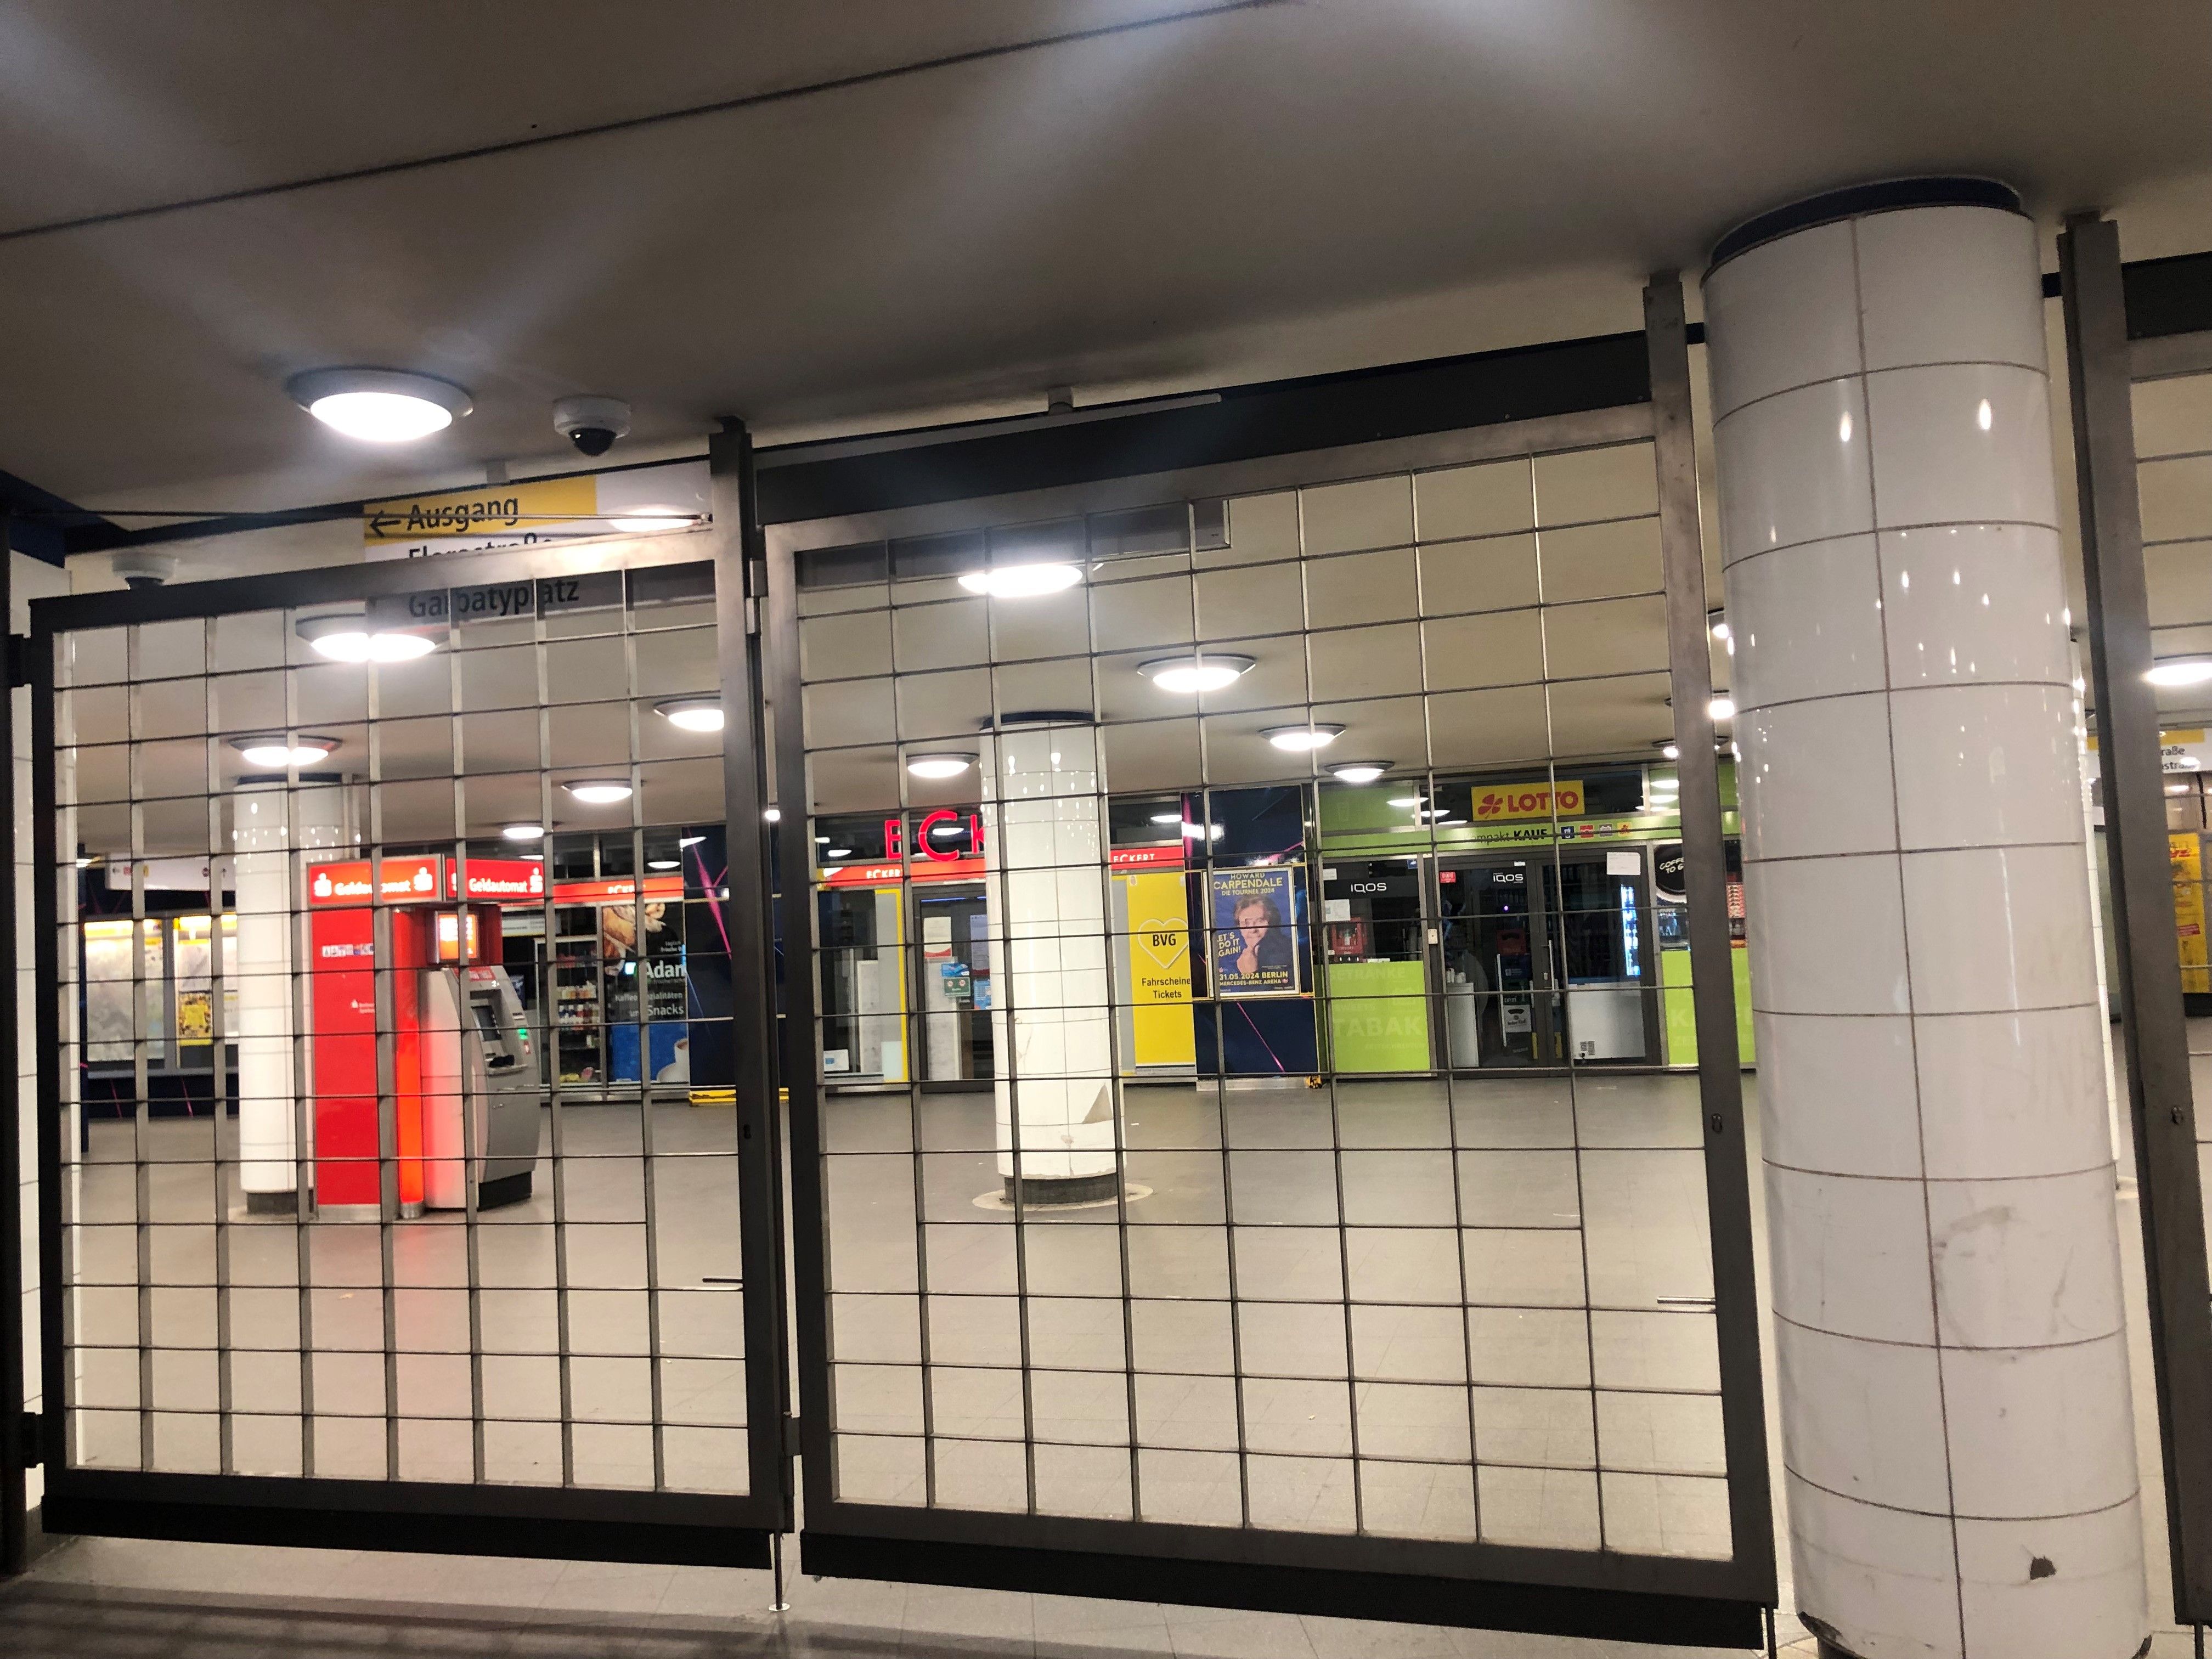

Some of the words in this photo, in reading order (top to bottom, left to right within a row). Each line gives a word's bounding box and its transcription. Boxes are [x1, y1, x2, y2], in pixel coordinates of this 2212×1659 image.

[407, 498, 518, 532] Ausgang
[1508, 791, 1578, 812] LOTTO
[1514, 829, 1547, 841] KAUF
[1113, 853, 1155, 863] ECKERT
[866, 868, 902, 879] ECKER
[469, 878, 528, 893] Geldautomat
[1214, 877, 1283, 890] CARPENDALE
[1351, 882, 1387, 893] IQOS
[1153, 933, 1176, 946] BVG
[1217, 932, 1235, 943] ET'S
[1219, 940, 1231, 950] DO
[1233, 938, 1240, 946] IT
[1142, 977, 1191, 986] Fahrscheine
[1219, 972, 1260, 981] 31.05.2024
[1262, 970, 1288, 979] BERLIN
[1153, 990, 1182, 998] Tickets
[647, 1003, 684, 1016] Snacks
[1333, 1016, 1423, 1036] TABAK
